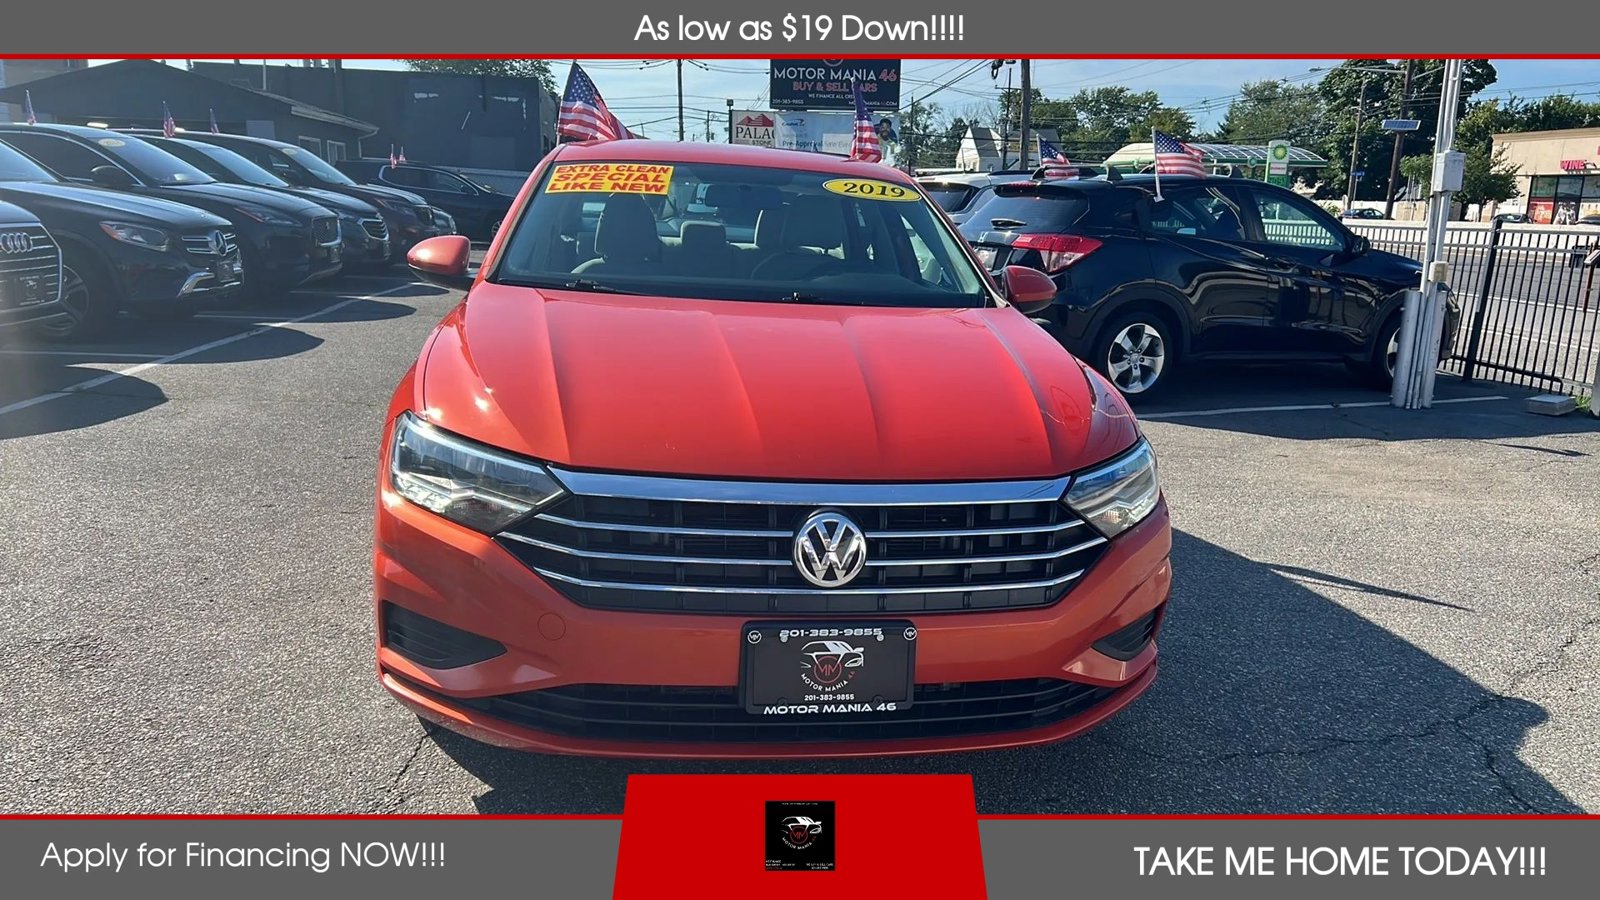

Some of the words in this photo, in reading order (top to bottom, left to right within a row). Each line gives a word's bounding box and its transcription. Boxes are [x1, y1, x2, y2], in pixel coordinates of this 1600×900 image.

[774, 67, 826, 80] MOTOR
[830, 69, 877, 81] MANIA
[879, 69, 898, 82] 46
[793, 81, 814, 92] BUY
[816, 82, 824, 92] &
[826, 82, 849, 93] SELL
[556, 165, 610, 173] EXTRA
[615, 165, 669, 174] CLEAN
[1560, 160, 1585, 170] WINE
[554, 173, 665, 182] SPECIAL
[610, 183, 666, 192] NEW
[844, 183, 905, 197] 2019
[779, 627, 883, 638] 201-383-9855
[800, 672, 824, 692] MOTOR
[825, 679, 849, 692] MANIA
[804, 693, 855, 701] 201-383-9855
[763, 704, 820, 715] MOTOR
[823, 702, 873, 714] MANIA
[876, 702, 897, 711] 46
